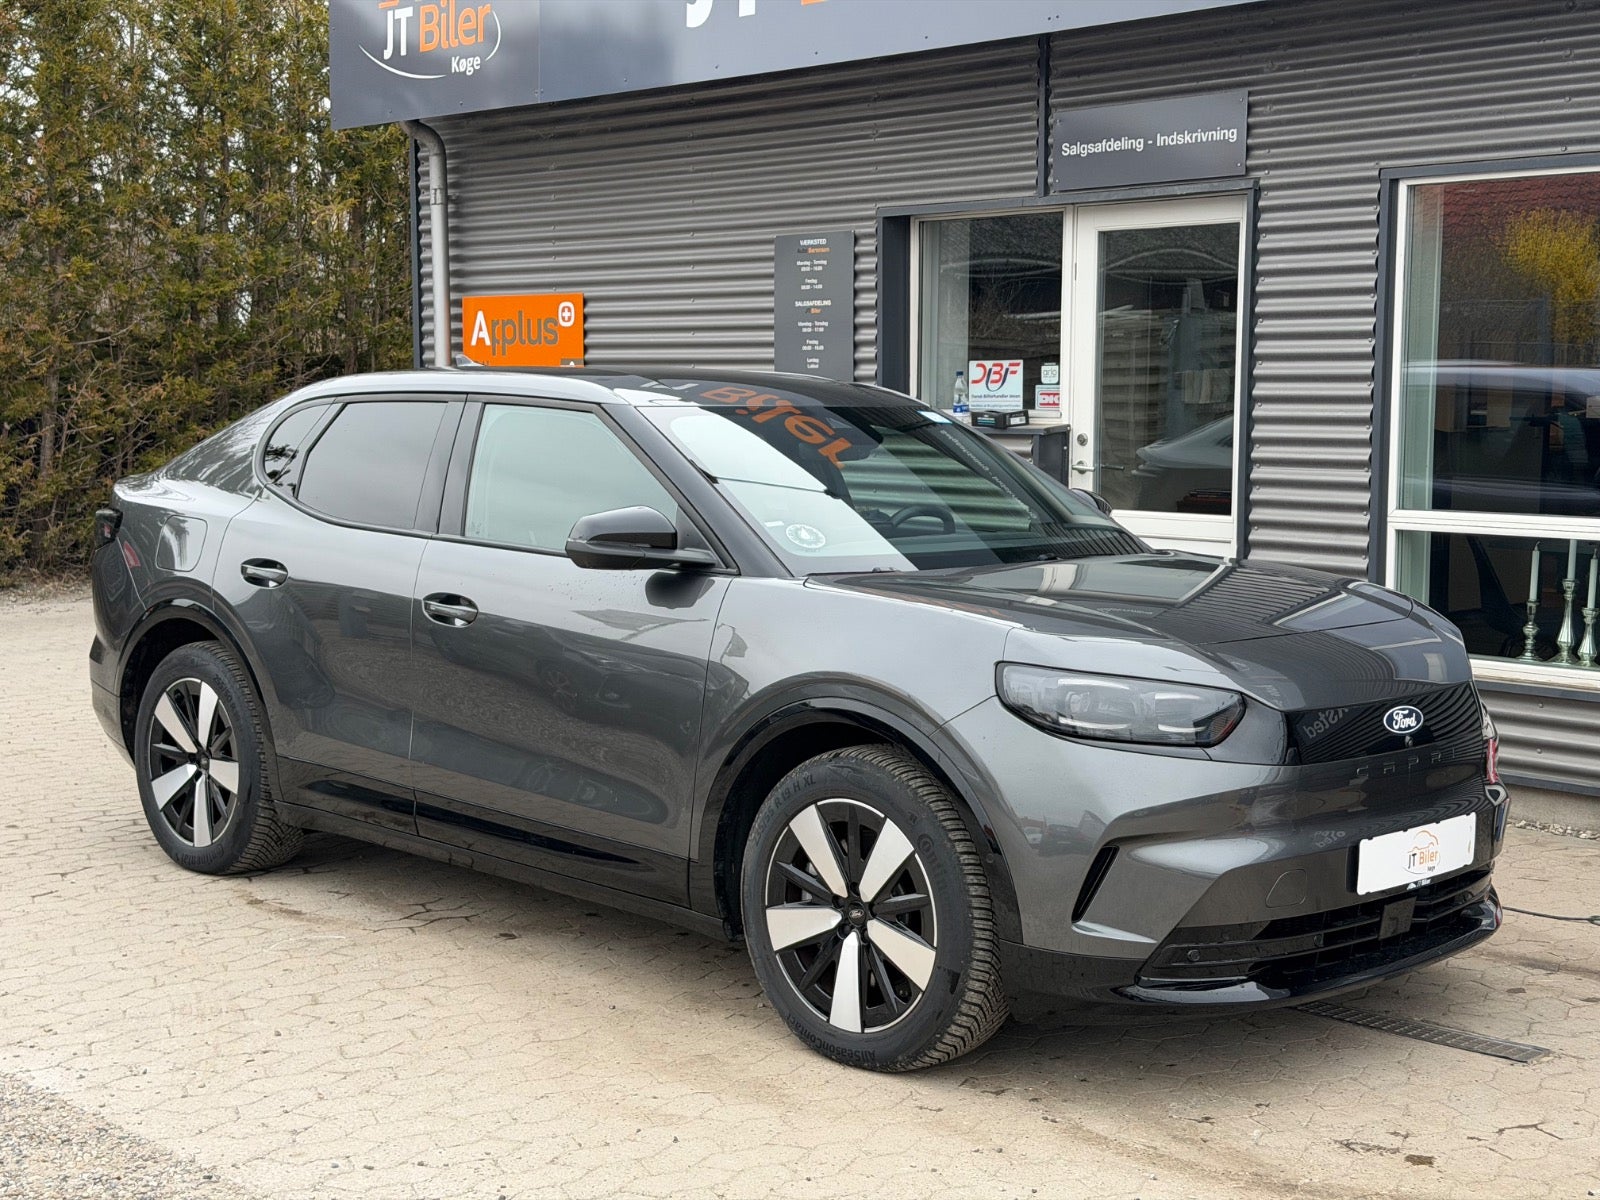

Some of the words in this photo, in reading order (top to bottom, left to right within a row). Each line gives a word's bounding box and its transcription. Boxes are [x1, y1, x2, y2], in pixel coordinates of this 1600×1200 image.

[383, 6, 414, 60] JT
[419, 0, 491, 53] Biler
[451, 55, 481, 76] Køge
[1061, 136, 1144, 157] Salgsafdeling
[1156, 127, 1238, 147] Indskrivning
[799, 238, 827, 246] VÆRKSTED
[1392, 709, 1417, 730] Ford
[1407, 853, 1417, 870] JT
[1419, 849, 1438, 865] Biler
